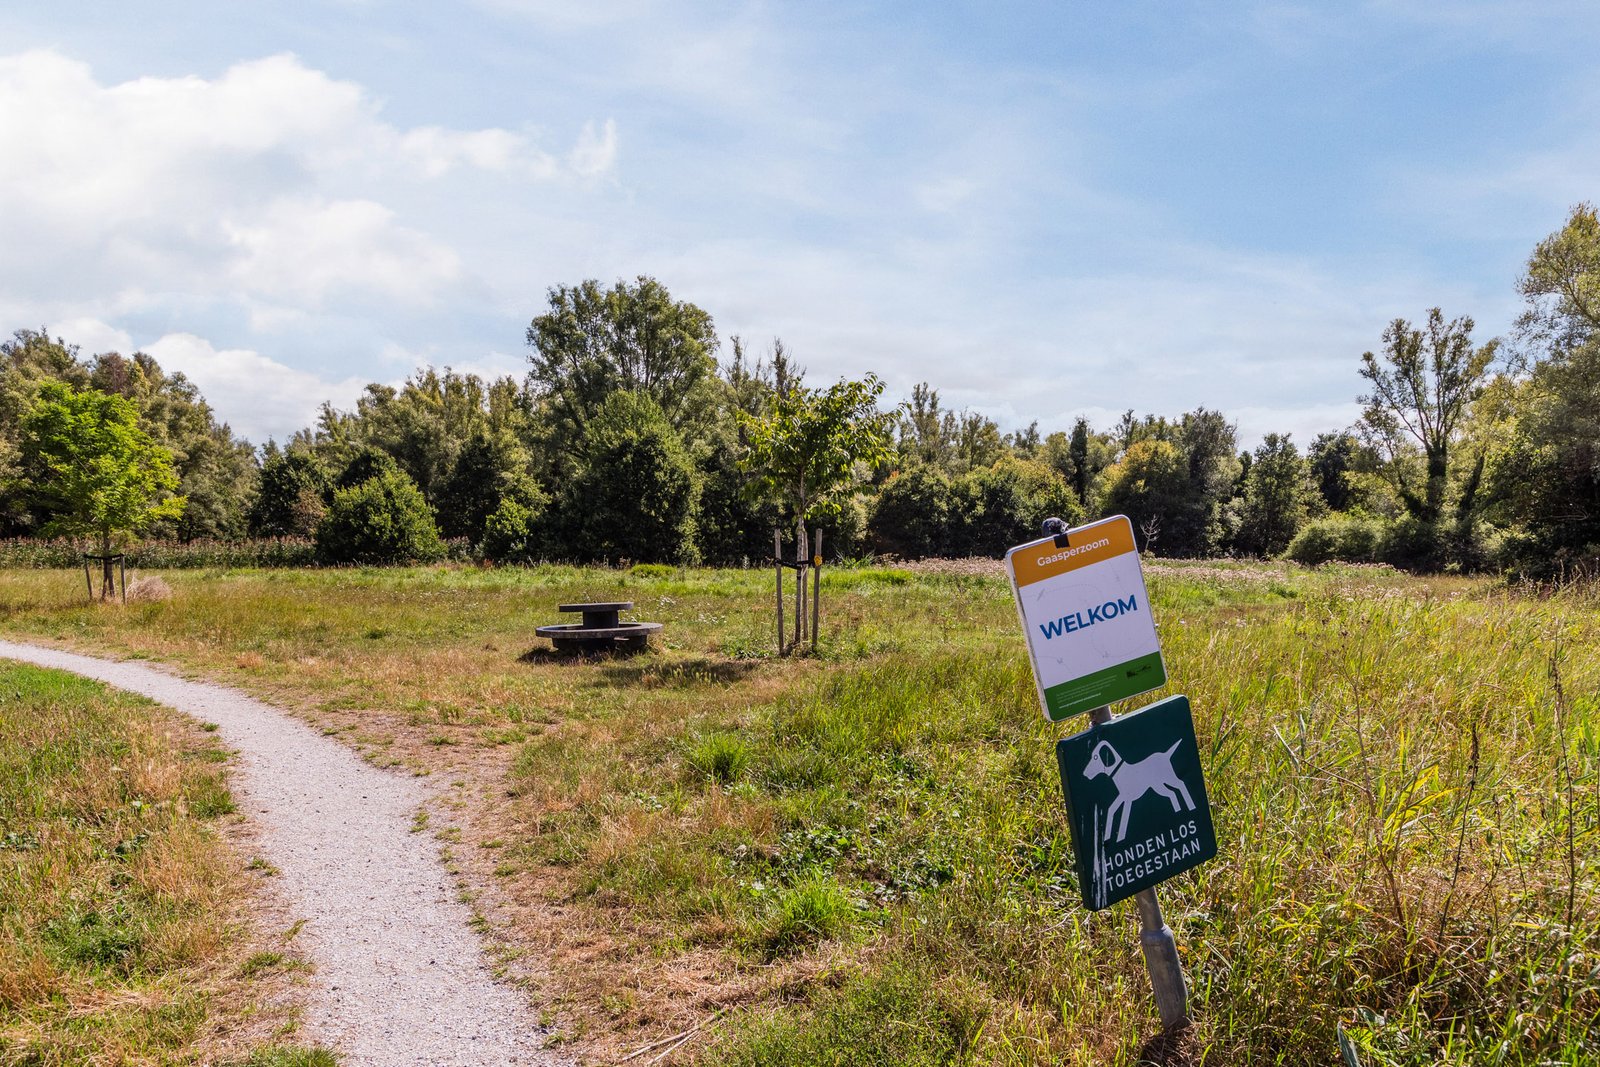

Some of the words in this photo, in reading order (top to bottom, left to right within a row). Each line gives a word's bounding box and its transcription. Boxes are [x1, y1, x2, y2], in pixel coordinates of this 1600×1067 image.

[1037, 537, 1110, 567] Gaasperzoom
[1040, 595, 1138, 640] WELKOM
[1104, 833, 1166, 873] HONDEN
[1170, 820, 1197, 843] LOS
[1105, 838, 1201, 892] TOEGESTAAN
